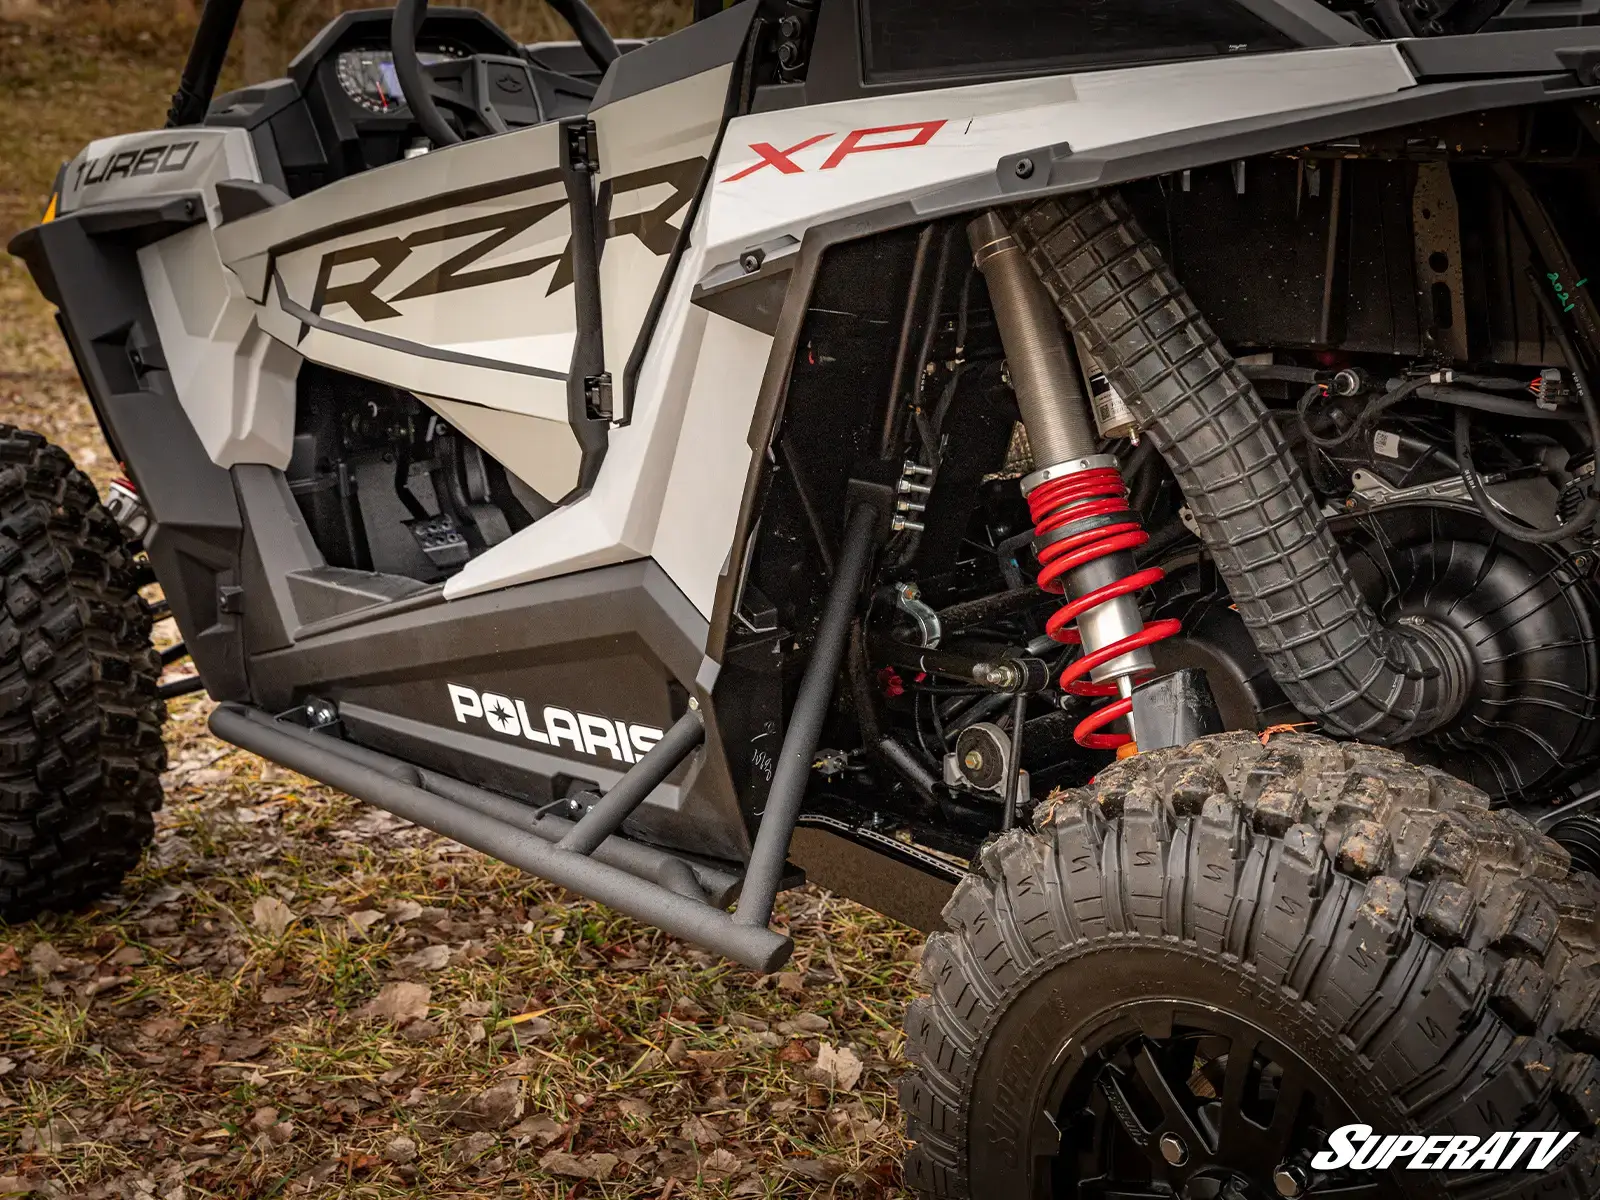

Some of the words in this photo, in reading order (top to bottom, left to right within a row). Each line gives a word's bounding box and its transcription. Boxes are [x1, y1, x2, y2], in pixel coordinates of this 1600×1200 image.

[73, 141, 200, 192] TURBO
[720, 119, 949, 183] XP
[300, 156, 709, 342] RZR
[1546, 272, 1575, 313] 2021
[447, 684, 665, 764] POLARIS
